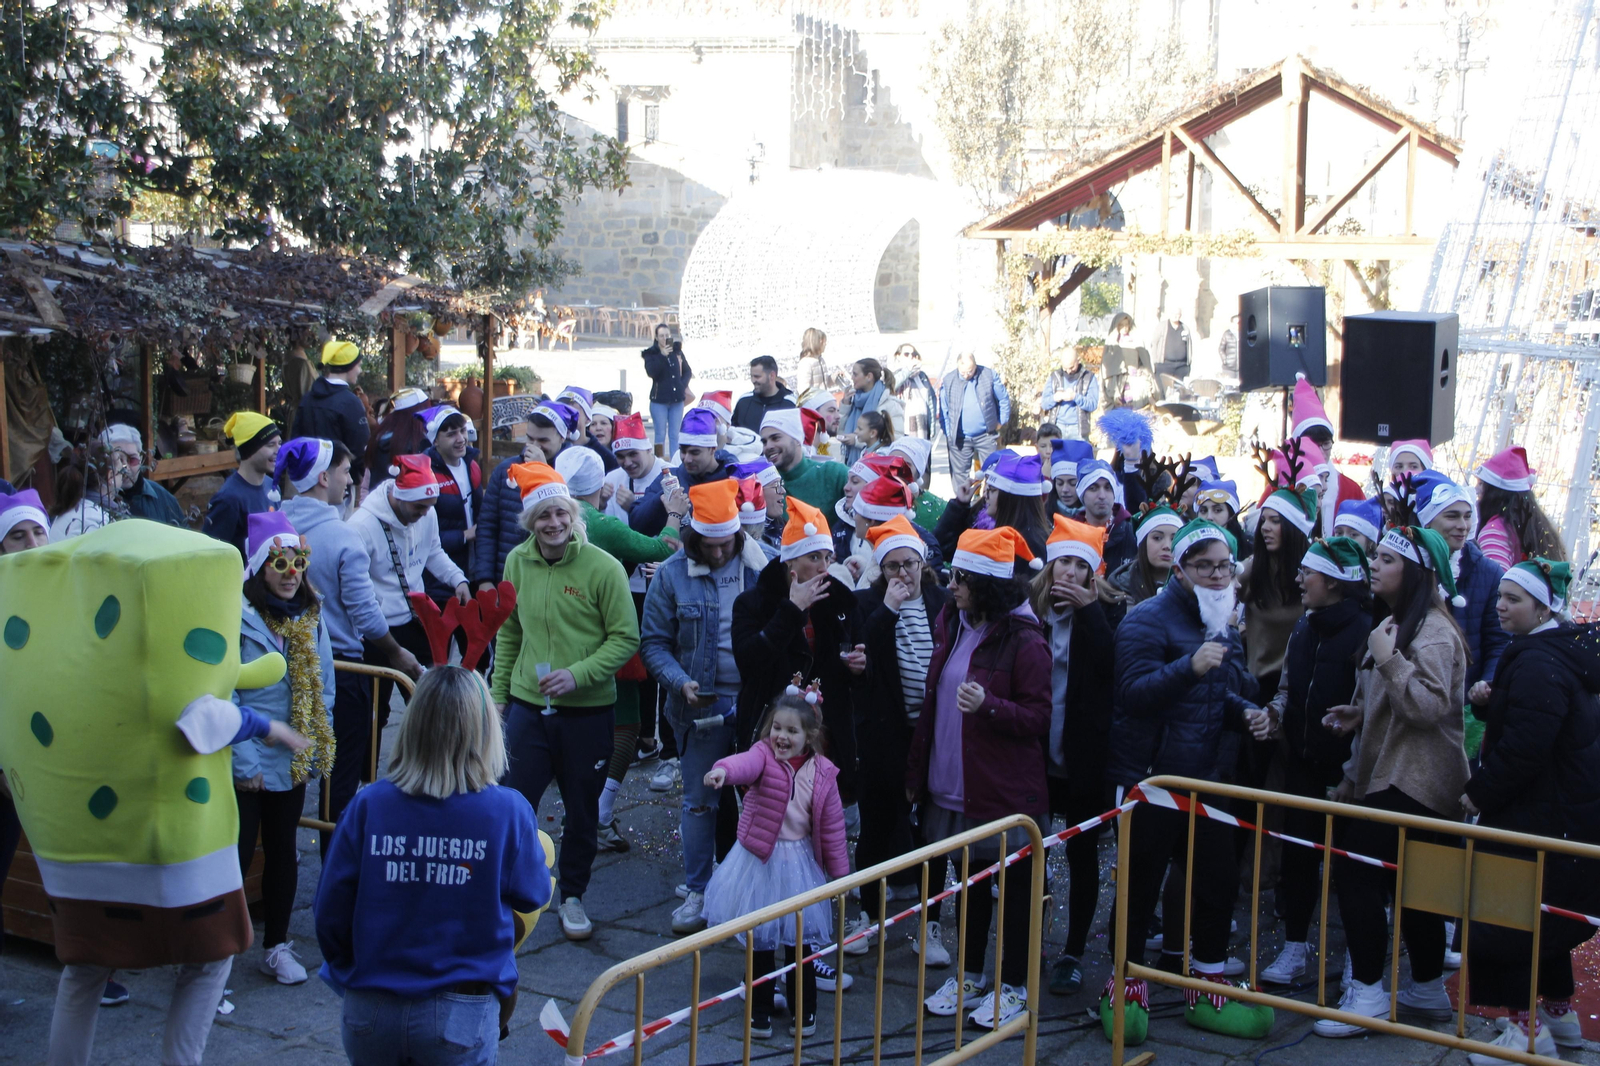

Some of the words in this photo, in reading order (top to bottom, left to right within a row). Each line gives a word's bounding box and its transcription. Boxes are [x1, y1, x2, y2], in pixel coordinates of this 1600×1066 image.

[1388, 533, 1410, 549] MILAR
[370, 834, 406, 856] LOS
[412, 836, 487, 860] JUEGOS
[386, 861, 420, 882] DEL
[426, 862, 470, 885] FRIO
